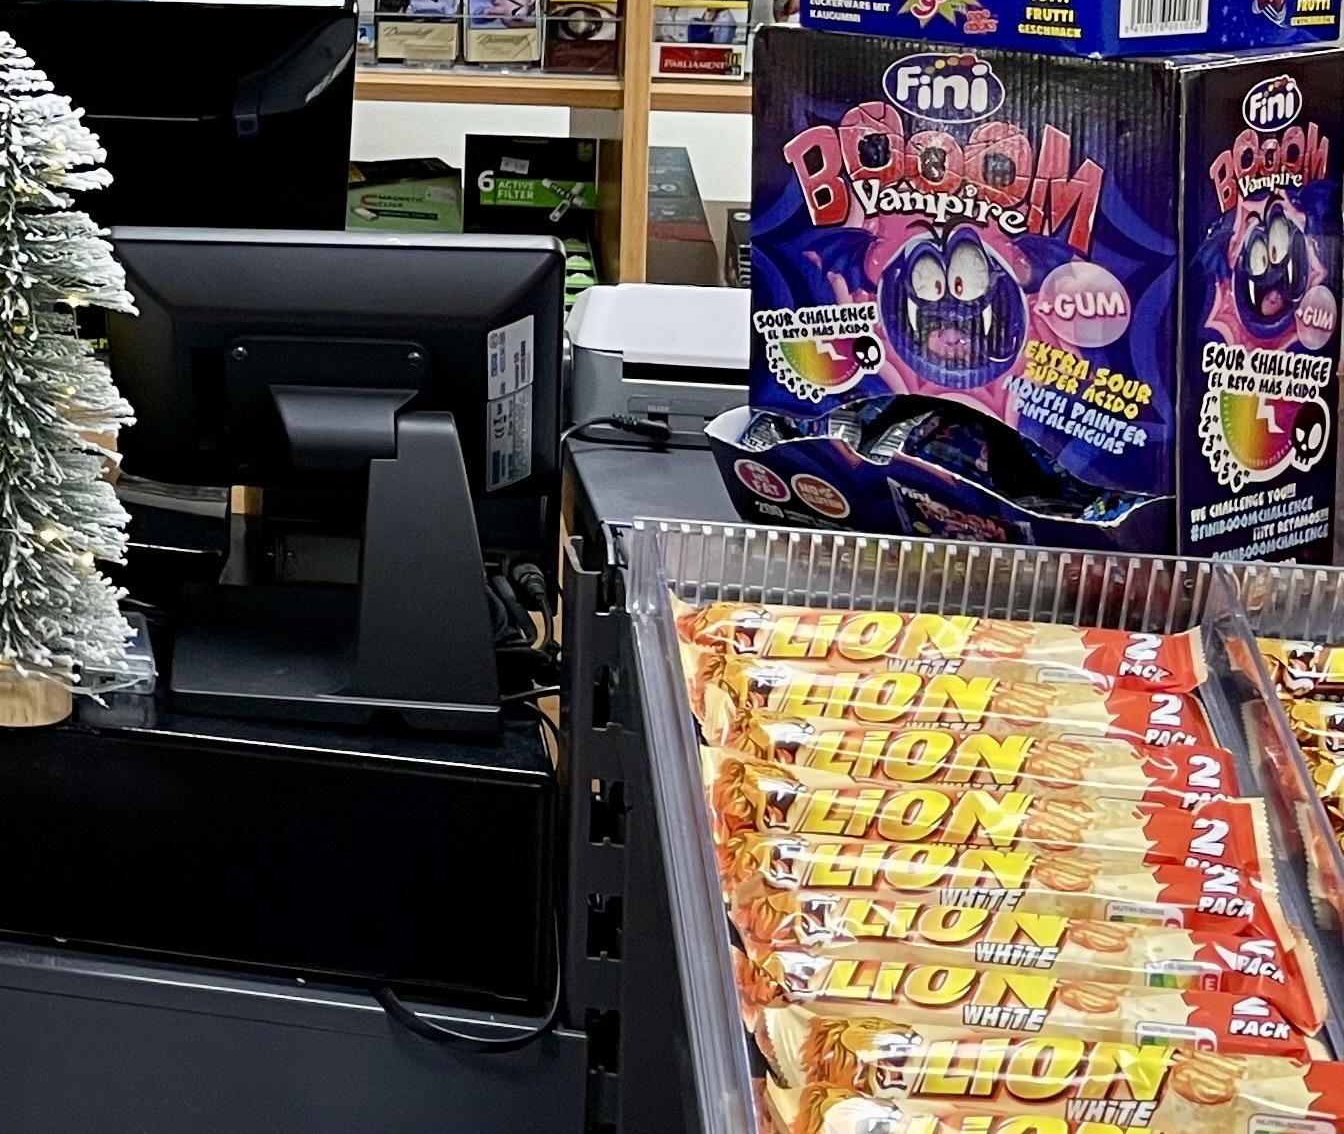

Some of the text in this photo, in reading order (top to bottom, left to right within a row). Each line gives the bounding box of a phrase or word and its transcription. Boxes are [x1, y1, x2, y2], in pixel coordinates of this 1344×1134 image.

[1025, 7, 1074, 22] FRUTTI
[1296, 0, 1331, 11] FRUTTI
[1018, 23, 1082, 37] GESCHMACK
[896, 65, 989, 116] Fini
[1249, 80, 1295, 124] Fini
[498, 180, 535, 192] ACTIVE
[783, 101, 1105, 256] BOOOM
[1238, 172, 1303, 198] Vampire
[498, 190, 535, 201] FILTER
[852, 178, 1028, 235] Vampire
[757, 306, 875, 328] SOUR CHALLENGE
[1038, 289, 1126, 320] +GUM
[768, 329, 779, 340] EL
[782, 327, 809, 339] RETO
[1023, 341, 1153, 405] EXTRA SOUR
[1023, 361, 1080, 396] SUPER
[1205, 346, 1330, 383] SOUR CHALLENGE
[1211, 372, 1223, 388] EL
[1228, 374, 1255, 392] RETO
[1002, 375, 1147, 447] MOUTH PAINTER
[1209, 492, 1264, 519] CHALLENGE
[765, 610, 979, 662] LION
[1121, 632, 1165, 661] 2
[1119, 660, 1168, 683] PACK
[782, 672, 997, 723] LION
[1148, 693, 1184, 726] 2
[813, 730, 1034, 786] LION
[808, 788, 1032, 845] LION
[974, 941, 1059, 970] WHITE
[961, 1004, 1049, 1031] WHITE
[1228, 1017, 1292, 1040] PACK
[910, 1036, 1175, 1100] LION
[1064, 1097, 1156, 1125] WHITE
